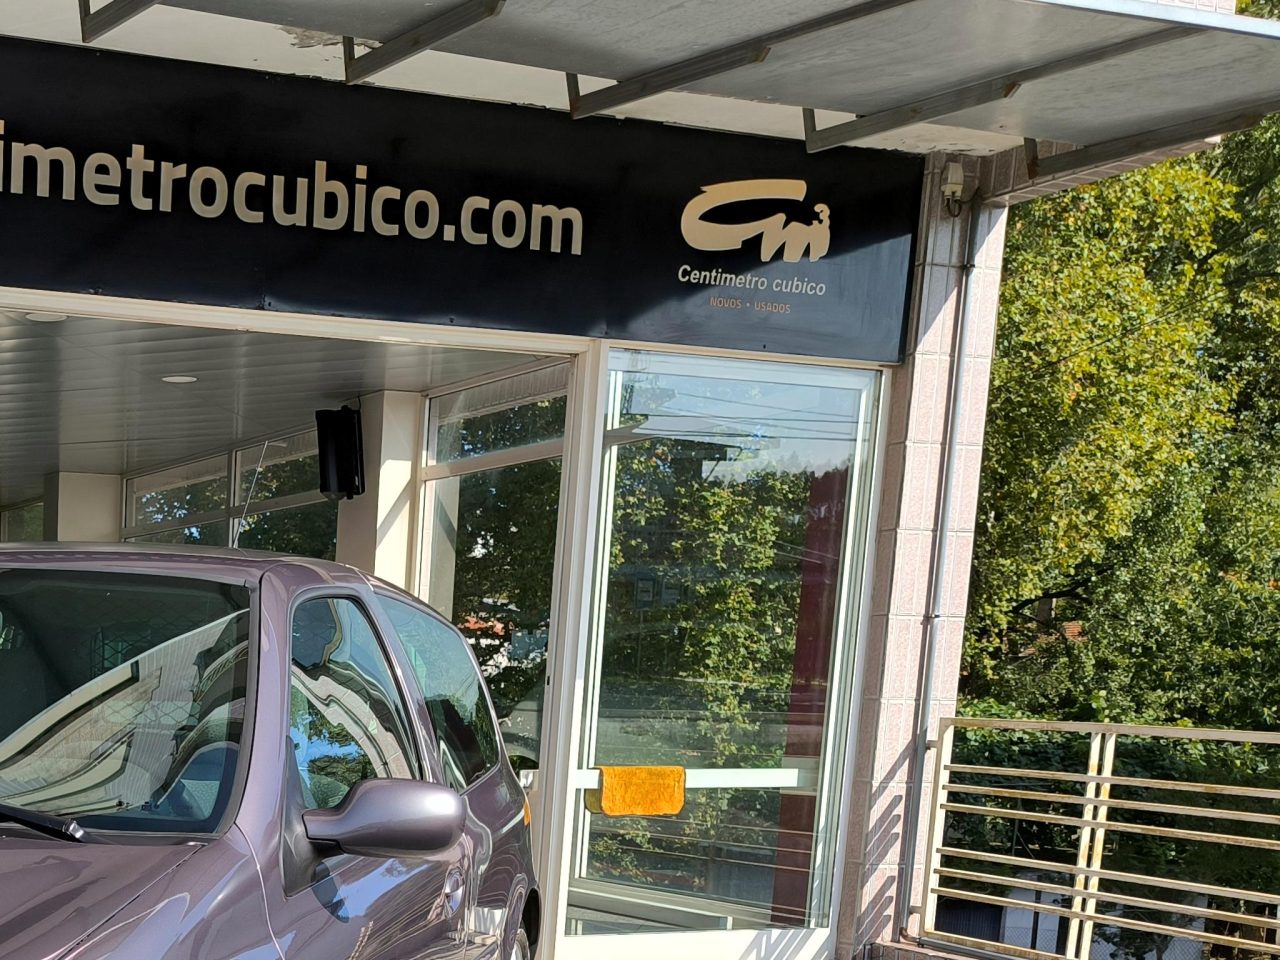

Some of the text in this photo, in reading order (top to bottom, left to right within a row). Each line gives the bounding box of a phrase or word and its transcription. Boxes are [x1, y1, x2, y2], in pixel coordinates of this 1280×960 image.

[677, 264, 826, 296] Centimetro cubico
[709, 296, 791, 314] NOVOS USADOS
